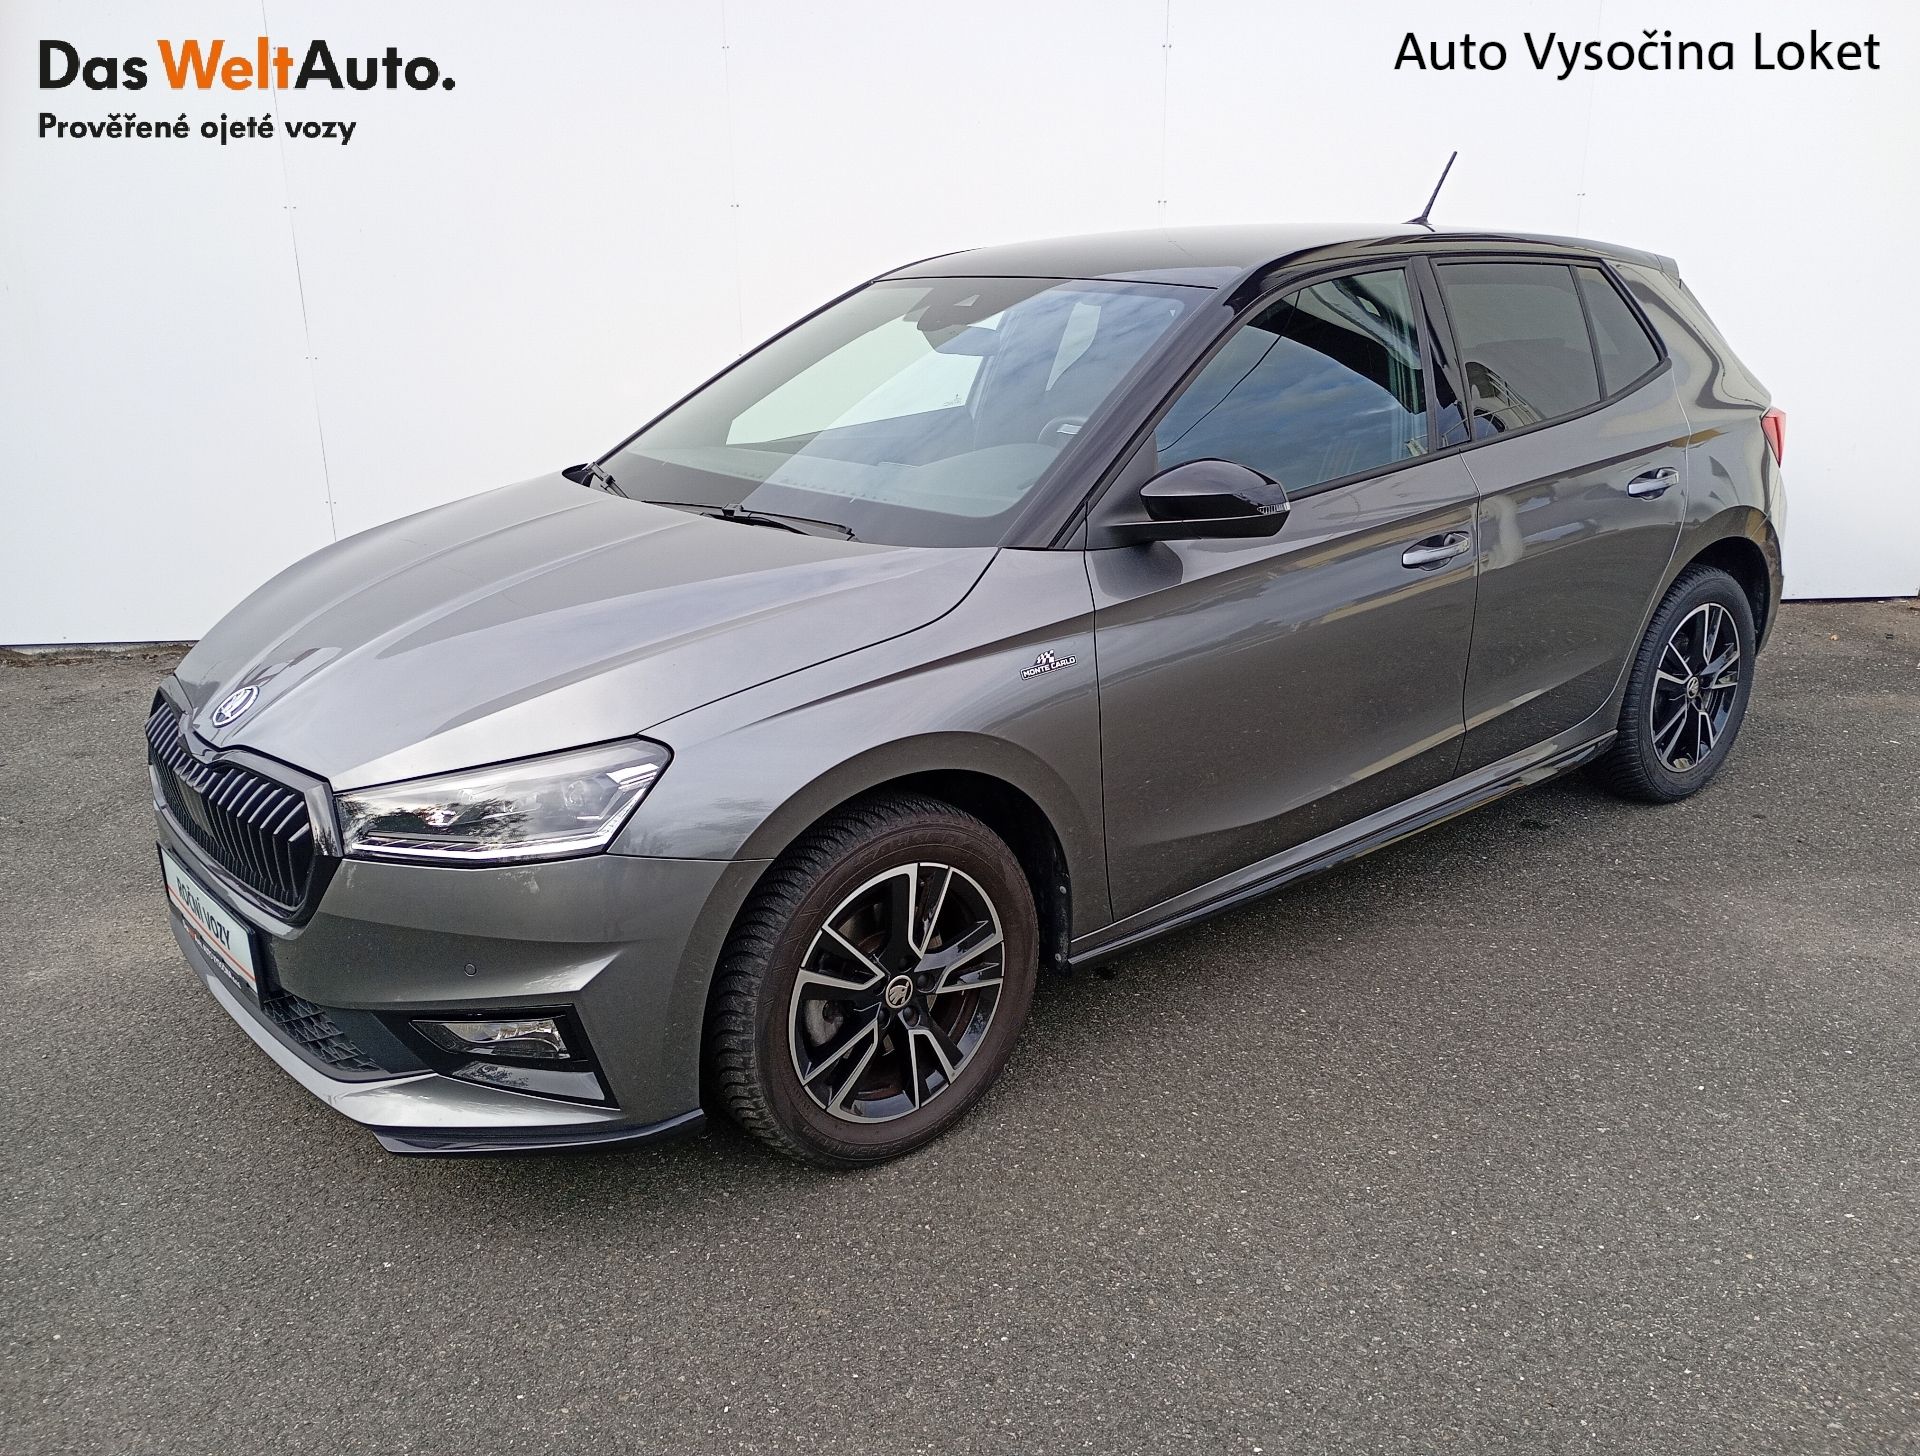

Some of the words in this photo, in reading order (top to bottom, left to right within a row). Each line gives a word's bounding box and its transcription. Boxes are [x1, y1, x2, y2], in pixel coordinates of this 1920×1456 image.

[1023, 664, 1050, 678] MONTE
[1051, 656, 1075, 669] CARLO
[202, 907, 231, 951] VOZY
